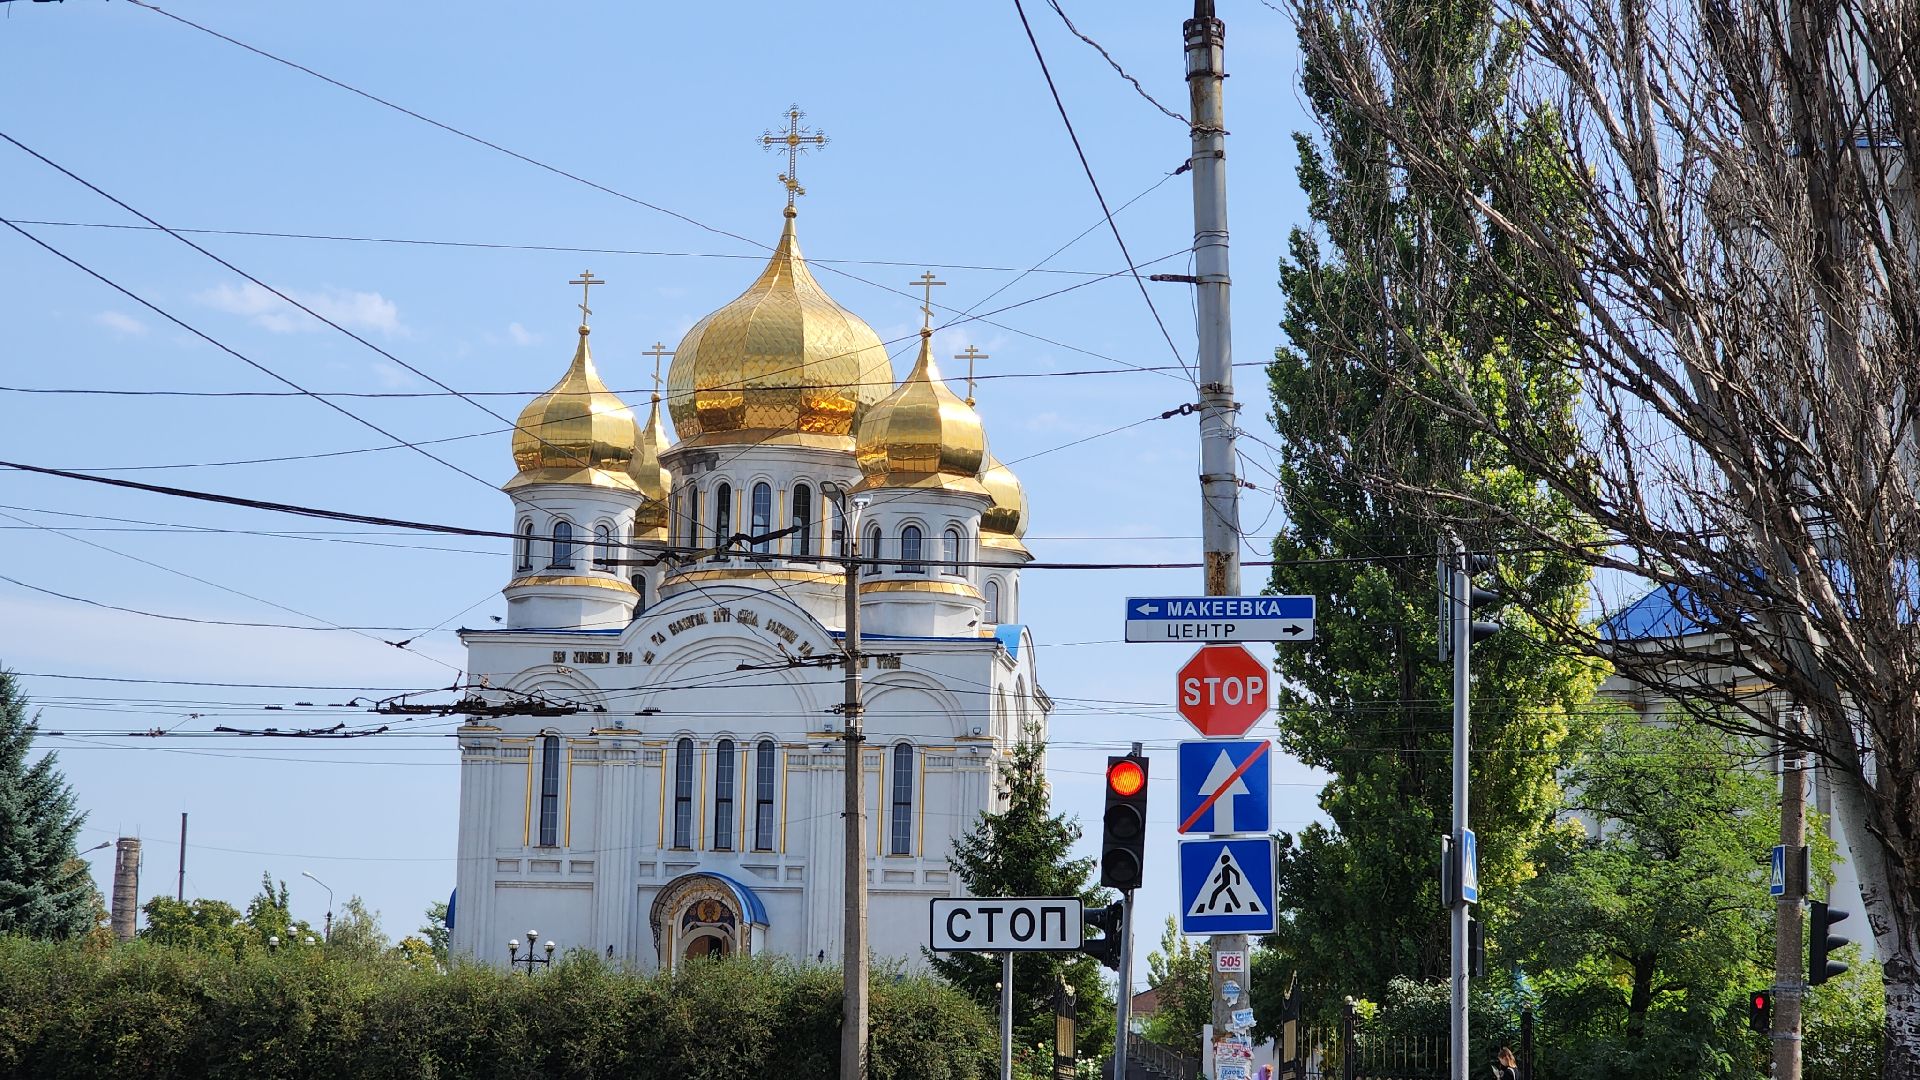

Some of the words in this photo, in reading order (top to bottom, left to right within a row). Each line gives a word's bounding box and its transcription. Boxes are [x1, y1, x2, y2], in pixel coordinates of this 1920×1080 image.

[1167, 601, 1281, 616] МАКЕЕВКА
[1168, 625, 1236, 639] ЦЕНТР
[1185, 677, 1263, 706] STOP
[948, 908, 1066, 942] СТОП
[1221, 956, 1241, 967] 505
